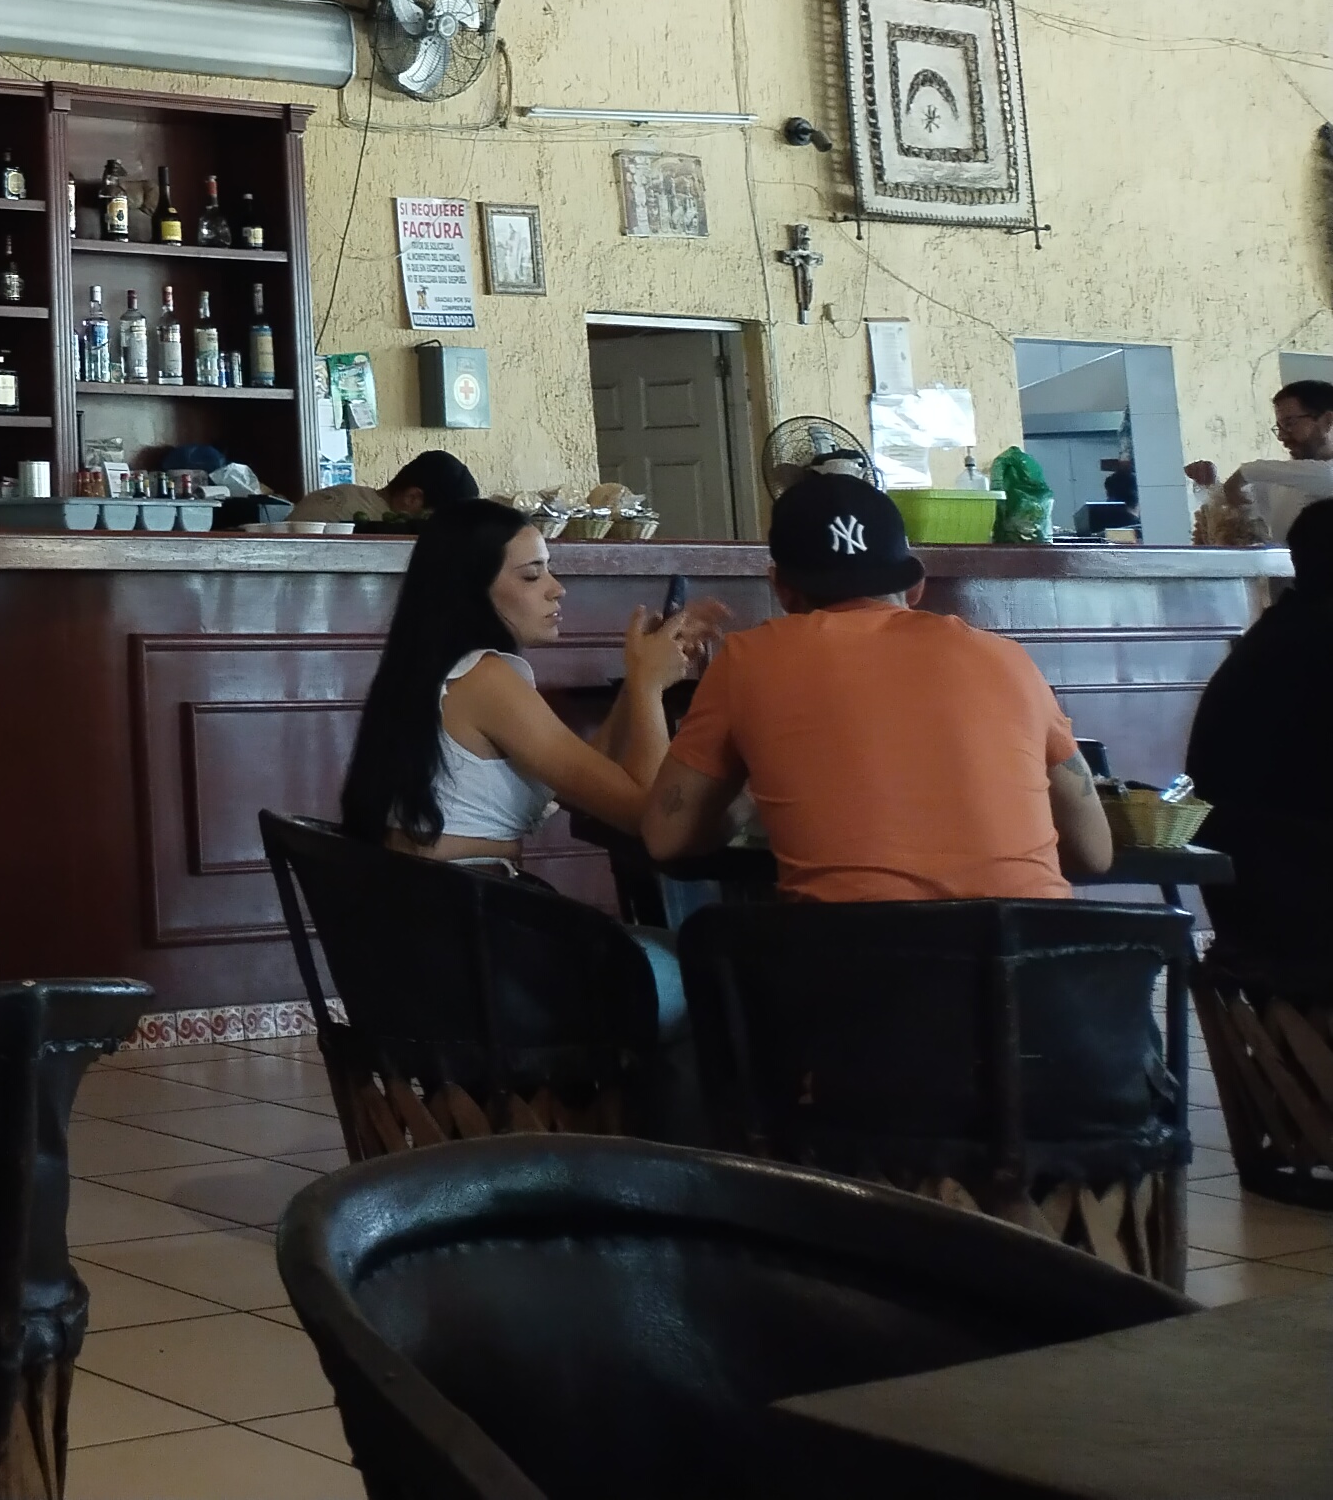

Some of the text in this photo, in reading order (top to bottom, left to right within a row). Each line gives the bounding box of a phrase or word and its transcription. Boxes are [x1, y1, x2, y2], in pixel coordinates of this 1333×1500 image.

[399, 202, 465, 218] SI REQUIERE
[402, 221, 464, 239] FACTURA
[445, 315, 472, 326] DORADO
[828, 514, 868, 555] NY
